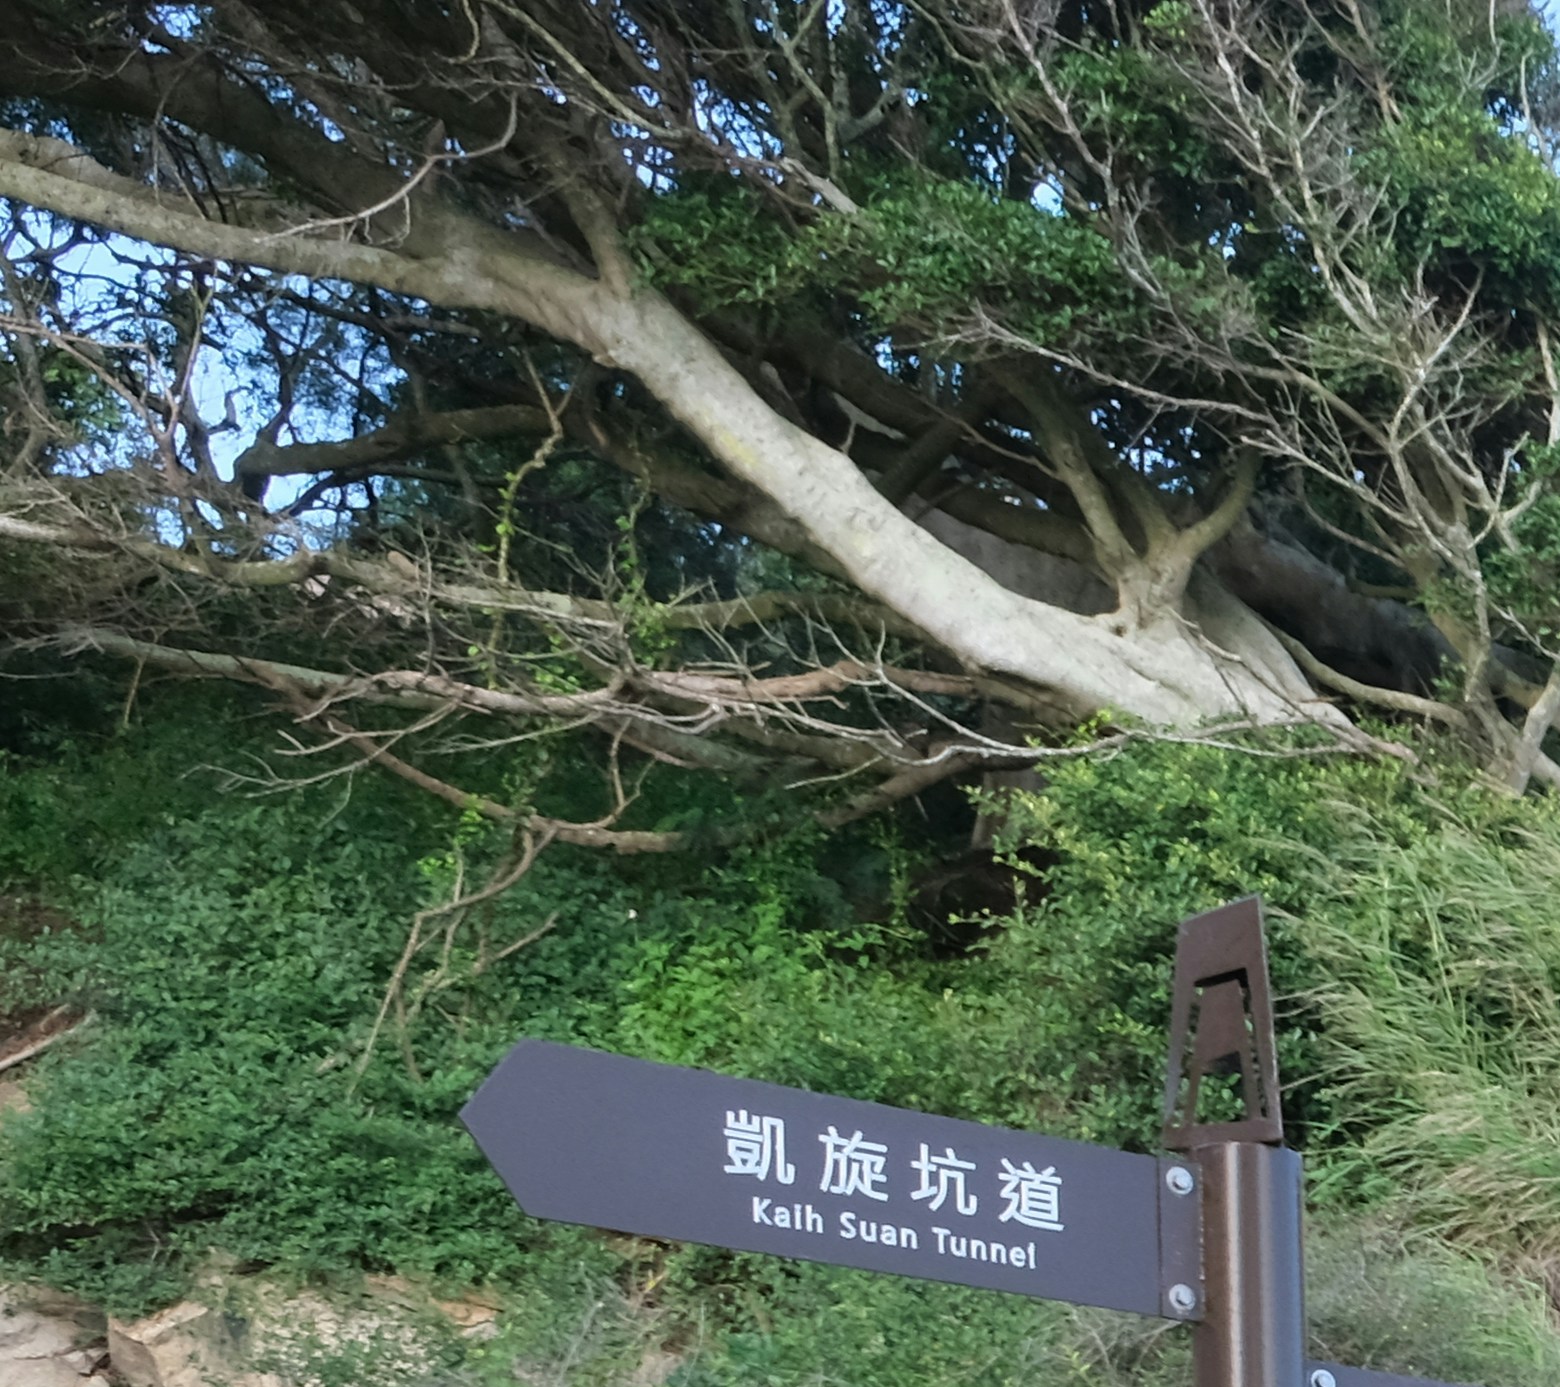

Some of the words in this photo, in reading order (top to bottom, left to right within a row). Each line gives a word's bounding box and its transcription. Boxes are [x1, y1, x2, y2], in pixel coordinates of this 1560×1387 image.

[723, 1109, 1065, 1232] 凱旋坑道
[839, 1211, 918, 1250] Suan
[932, 1226, 1037, 1270] Tunnel
